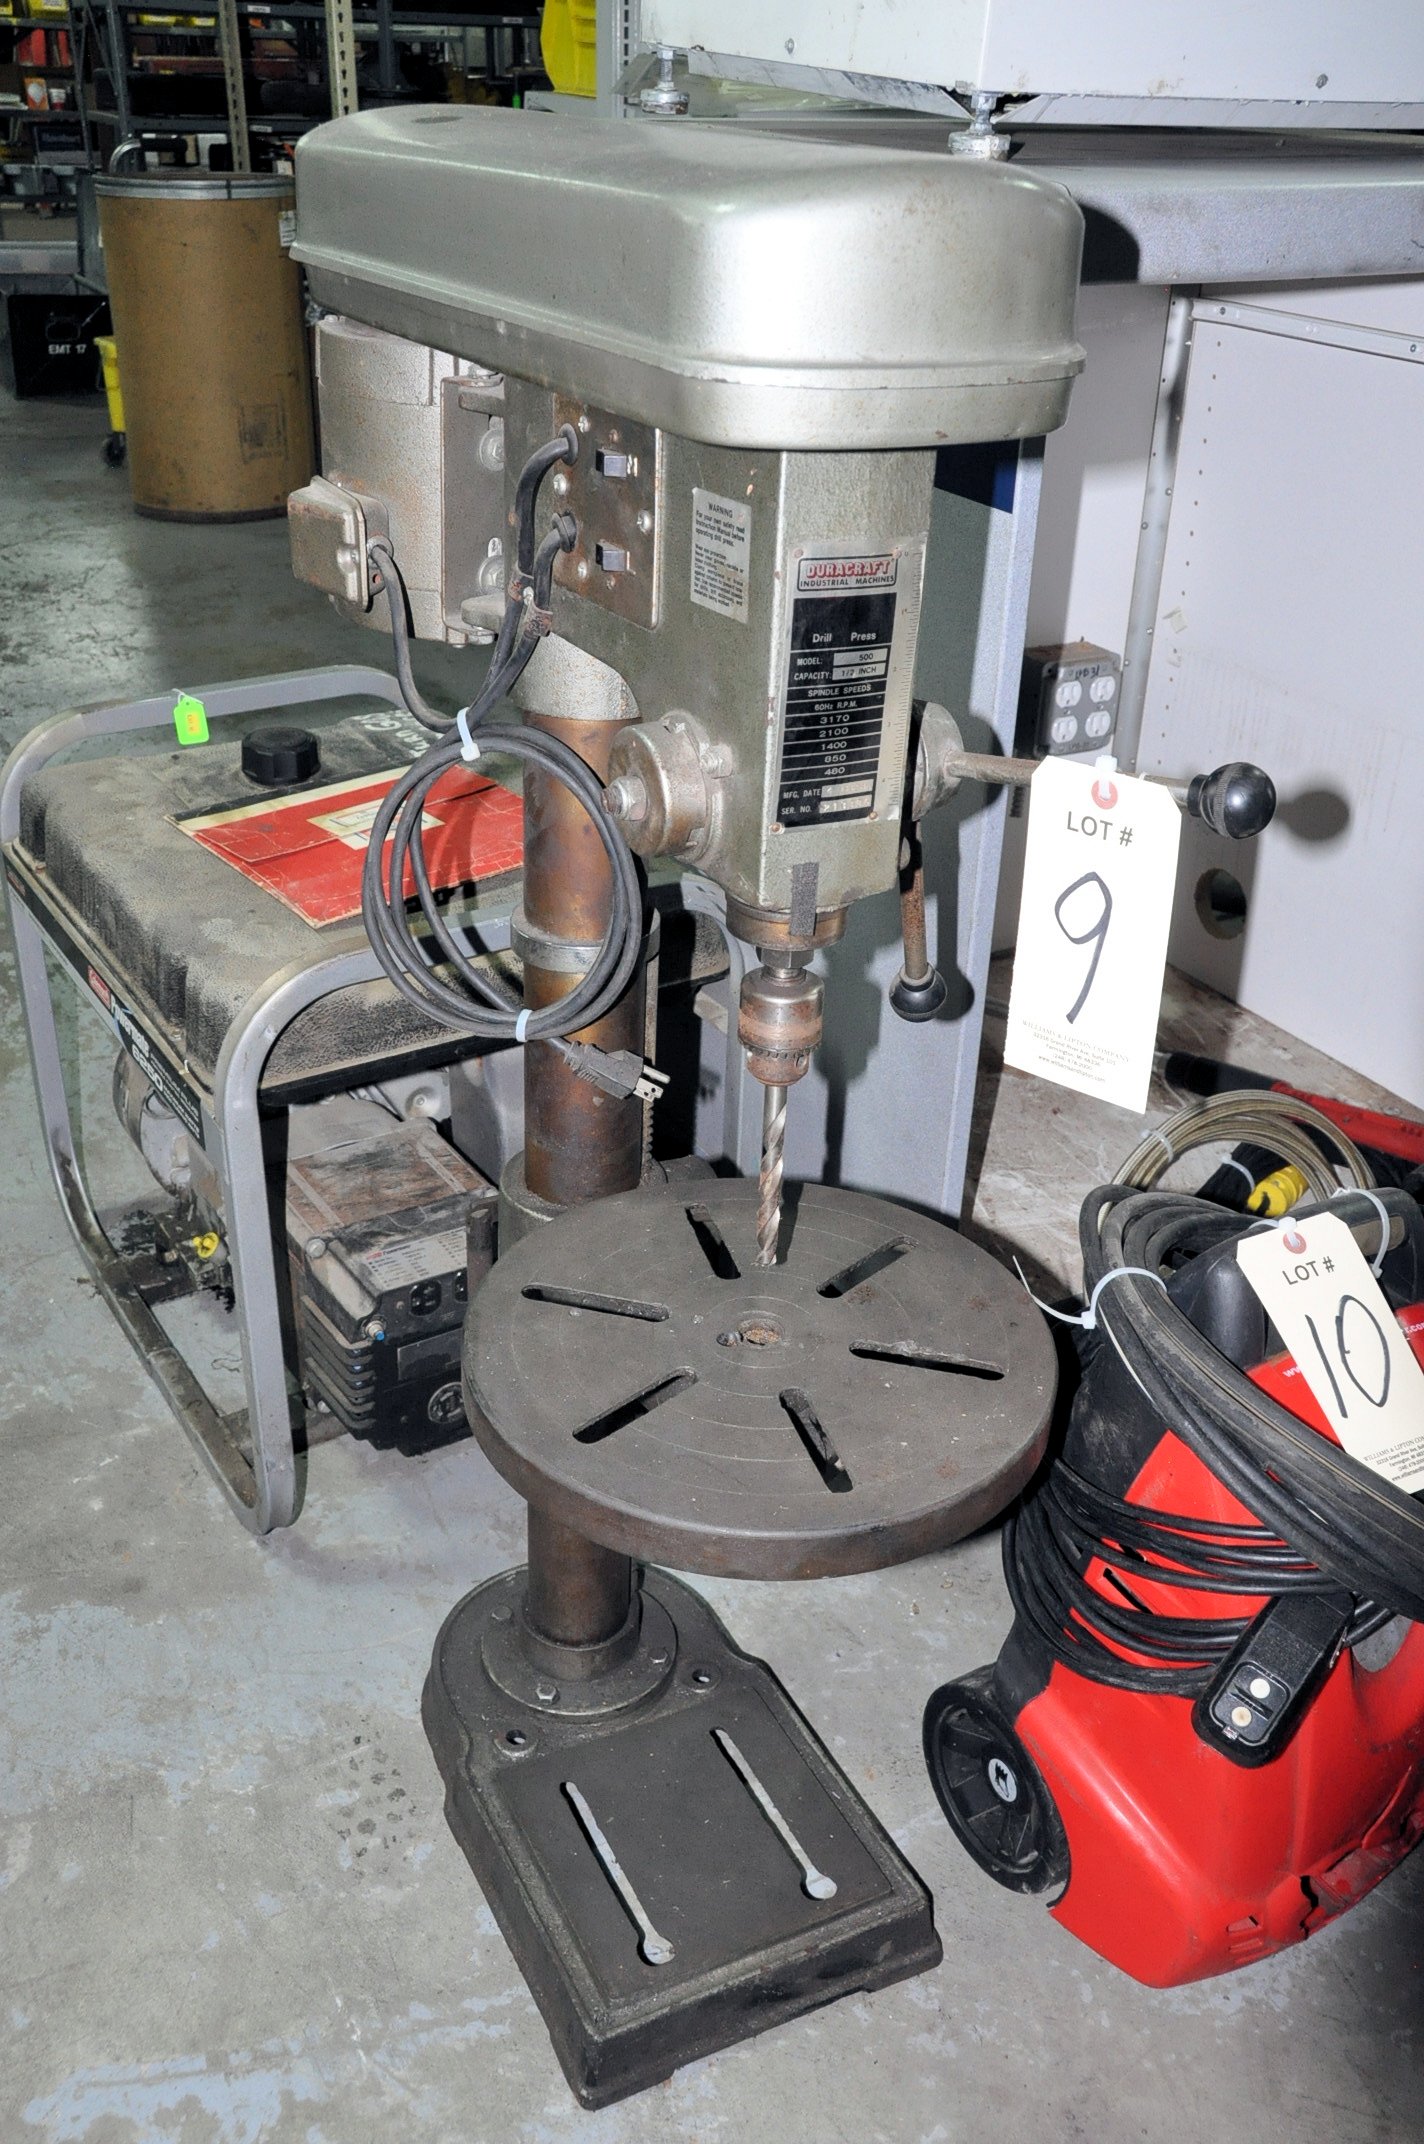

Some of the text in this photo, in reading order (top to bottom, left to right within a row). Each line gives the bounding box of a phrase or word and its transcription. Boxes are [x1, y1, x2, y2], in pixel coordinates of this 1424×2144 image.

[708, 502, 733, 518] WARNING
[806, 560, 891, 578] DURACRAFT
[800, 575, 895, 587] INDUSTRIAL MACHINES
[812, 632, 877, 643] Drill Press
[797, 658, 823, 666] MODEL:
[794, 672, 832, 680] CAPACITY:
[859, 666, 877, 674] INCH
[808, 684, 872, 697] SPINDLE SPEEDS
[836, 701, 858, 709] R.P.M.
[819, 714, 850, 724] 3170
[819, 727, 849, 738] 2100
[821, 741, 847, 750] 1400
[824, 754, 847, 763] 850
[1067, 811, 1133, 847] LOT #
[1054, 871, 1113, 1025] 9
[131, 1043, 163, 1092] 6250
[1282, 1256, 1335, 1285] LOT #
[1304, 1294, 1391, 1418] 10
